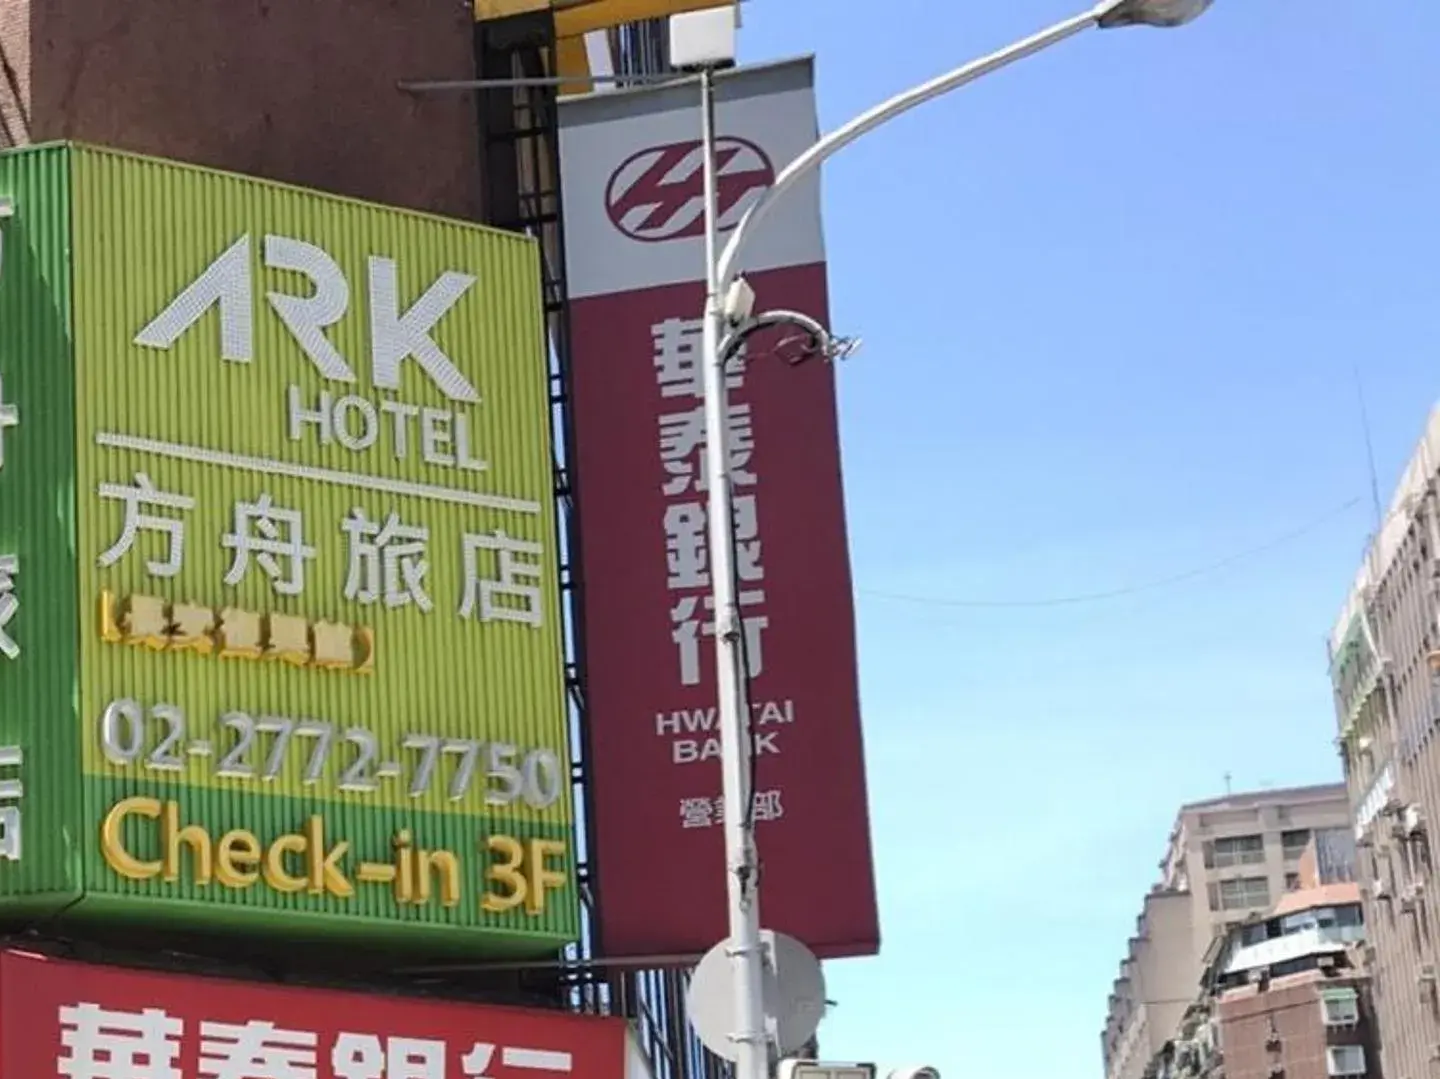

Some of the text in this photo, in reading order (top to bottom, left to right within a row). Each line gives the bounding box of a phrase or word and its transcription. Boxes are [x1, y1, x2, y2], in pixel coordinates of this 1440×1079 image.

[134, 232, 482, 402] ARK
[289, 385, 488, 471] HOTEL
[98, 474, 545, 630] 方舟旅店
[102, 697, 560, 809] 02-2772-7750
[656, 700, 795, 735] HWAI
[672, 731, 781, 764] BAK
[101, 798, 566, 914] Check-in 3F
